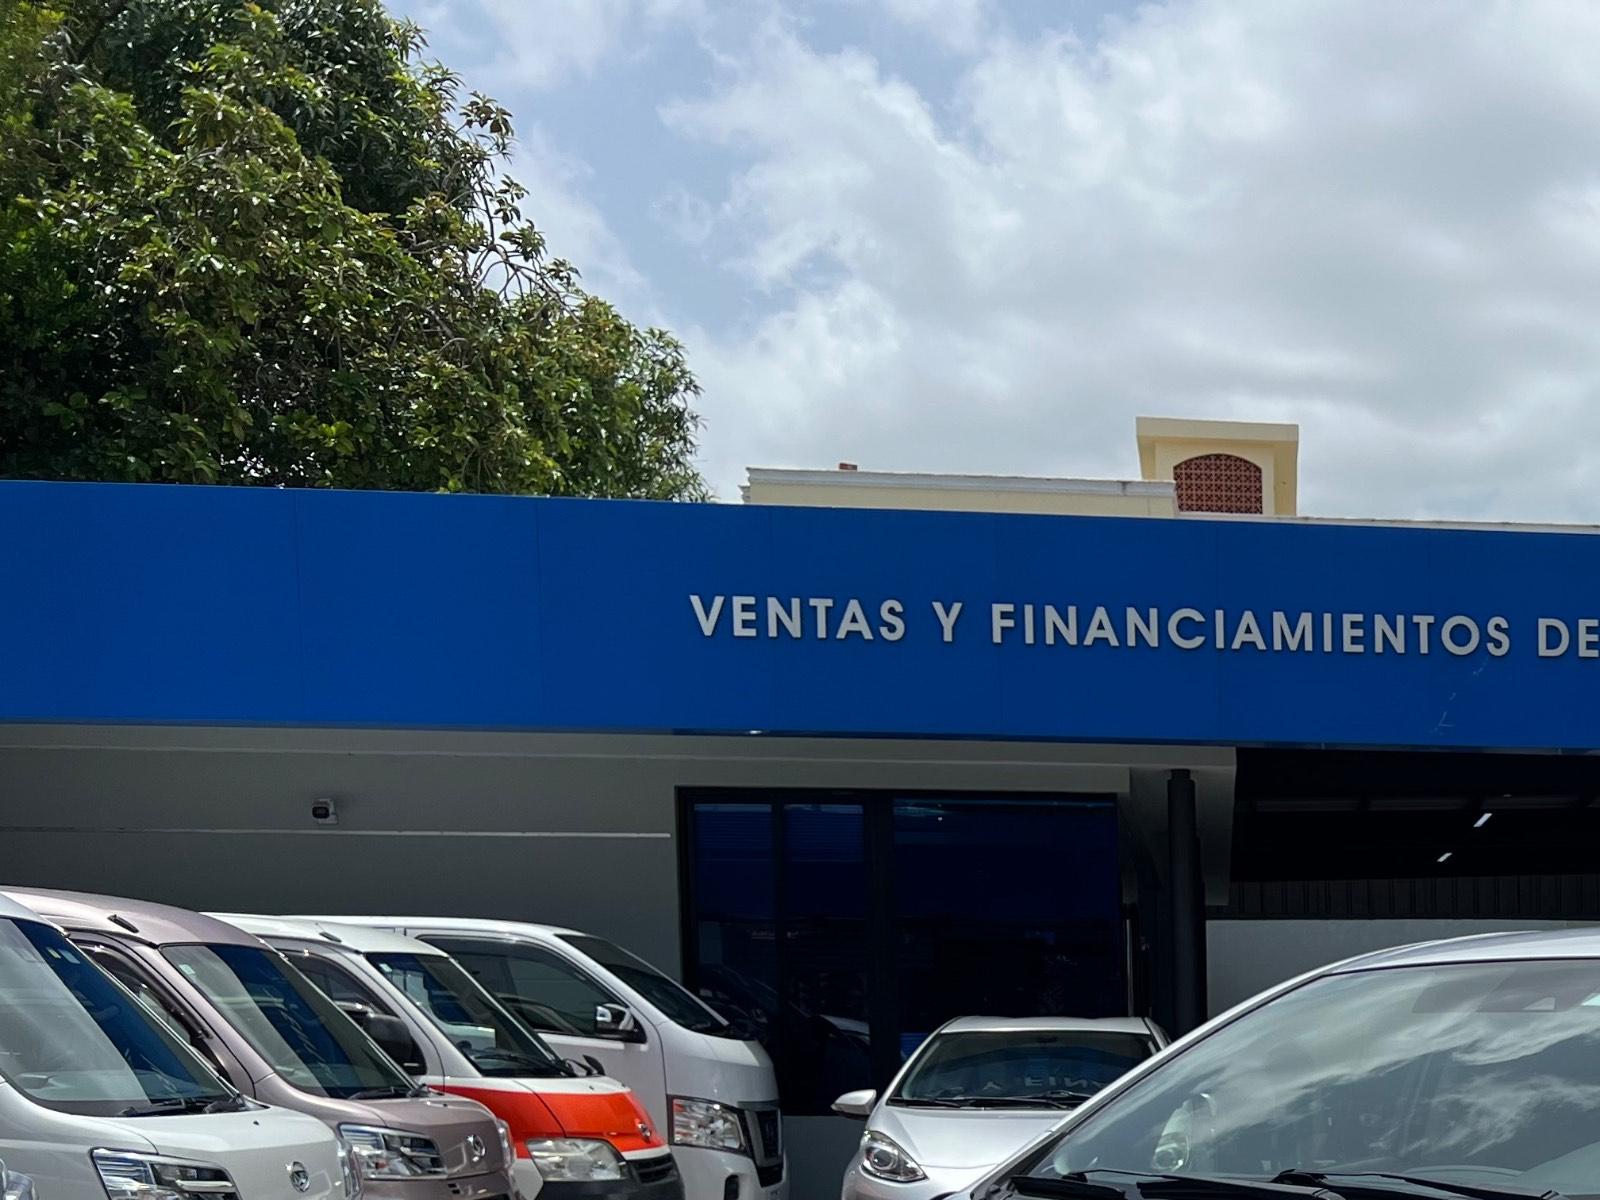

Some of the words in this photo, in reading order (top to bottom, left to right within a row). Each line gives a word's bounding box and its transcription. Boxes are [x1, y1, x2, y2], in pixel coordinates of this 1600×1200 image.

[689, 594, 905, 641] VENTAS
[932, 601, 963, 642] Y
[991, 603, 1510, 657] FINANCIAMIENTOS
[1537, 618, 1599, 658] DE
